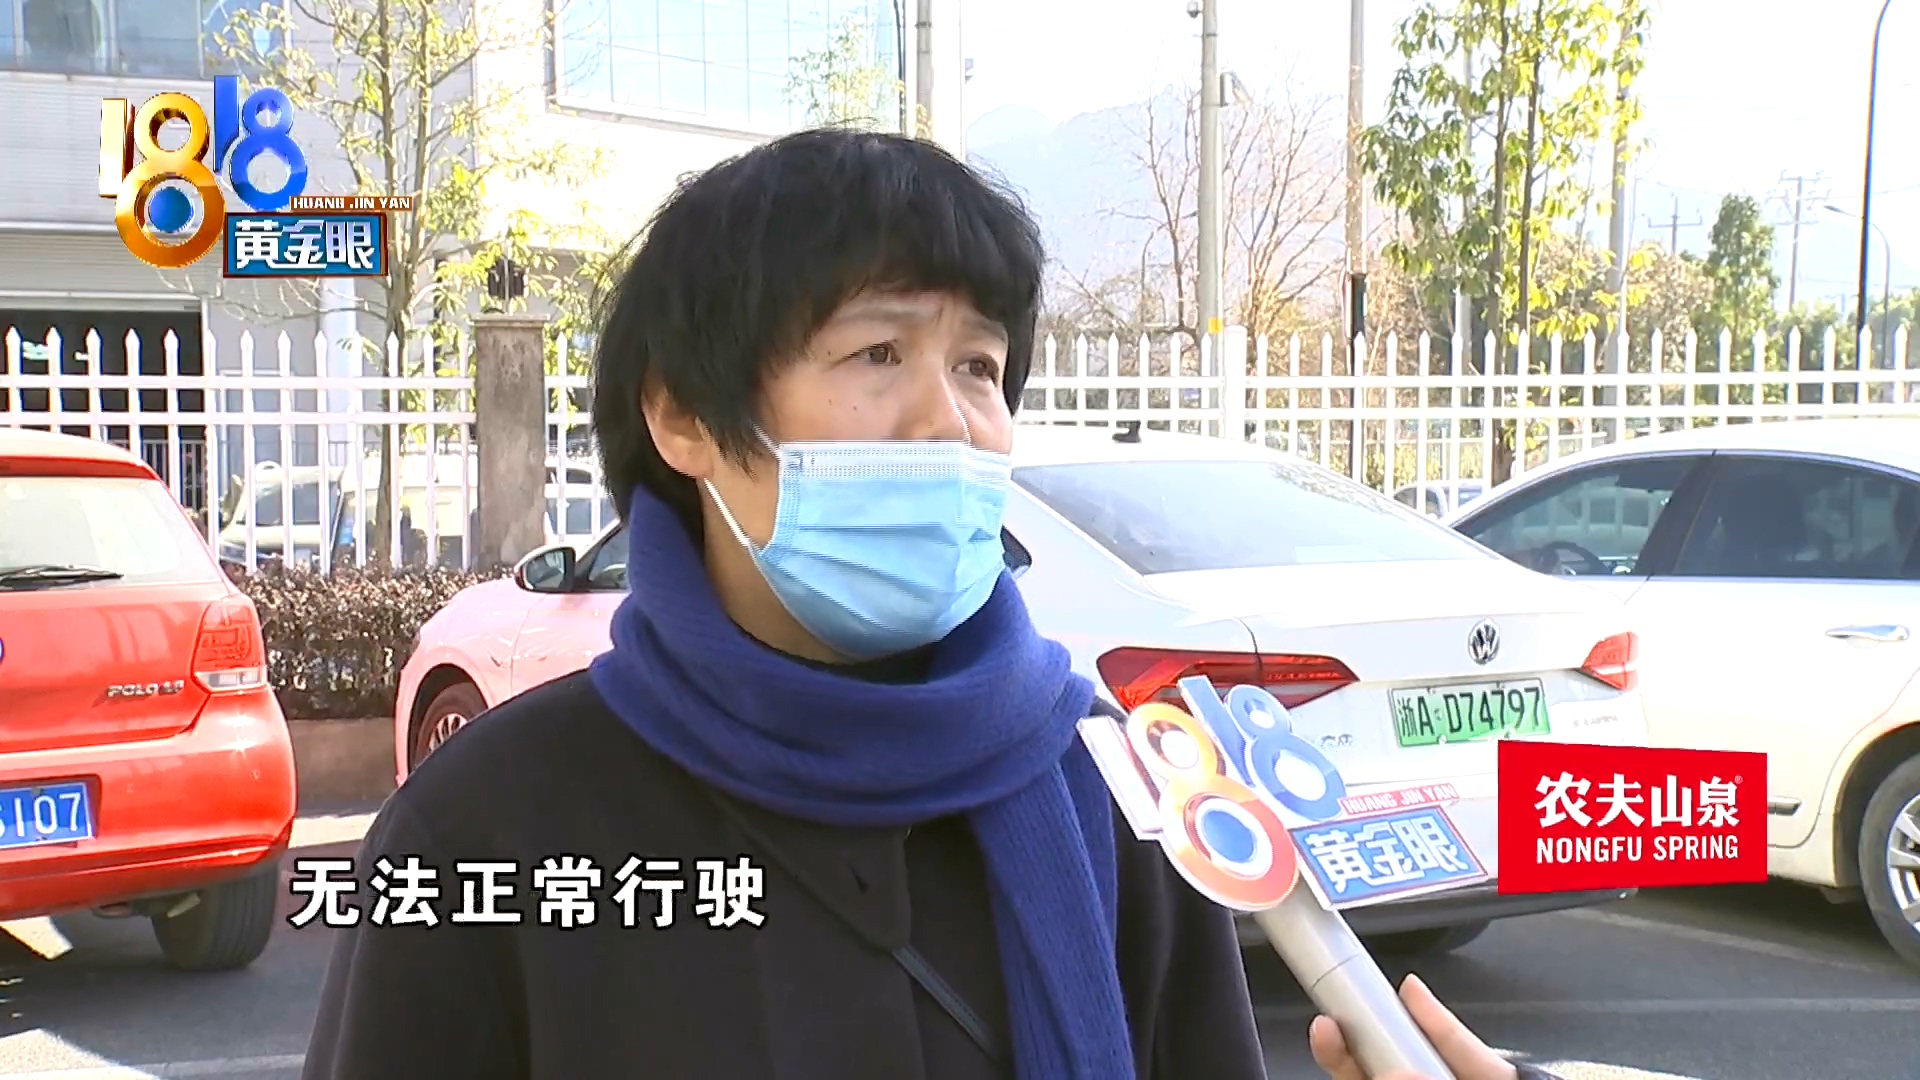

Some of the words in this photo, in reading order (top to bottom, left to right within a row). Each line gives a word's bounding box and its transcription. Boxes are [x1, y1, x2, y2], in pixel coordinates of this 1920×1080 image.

[107, 683, 159, 698] POLO
[1342, 792, 1398, 814] HUANG
[1400, 788, 1425, 806] JIN
[1423, 784, 1458, 802] YAN
[1305, 815, 1469, 893] 黄金眼
